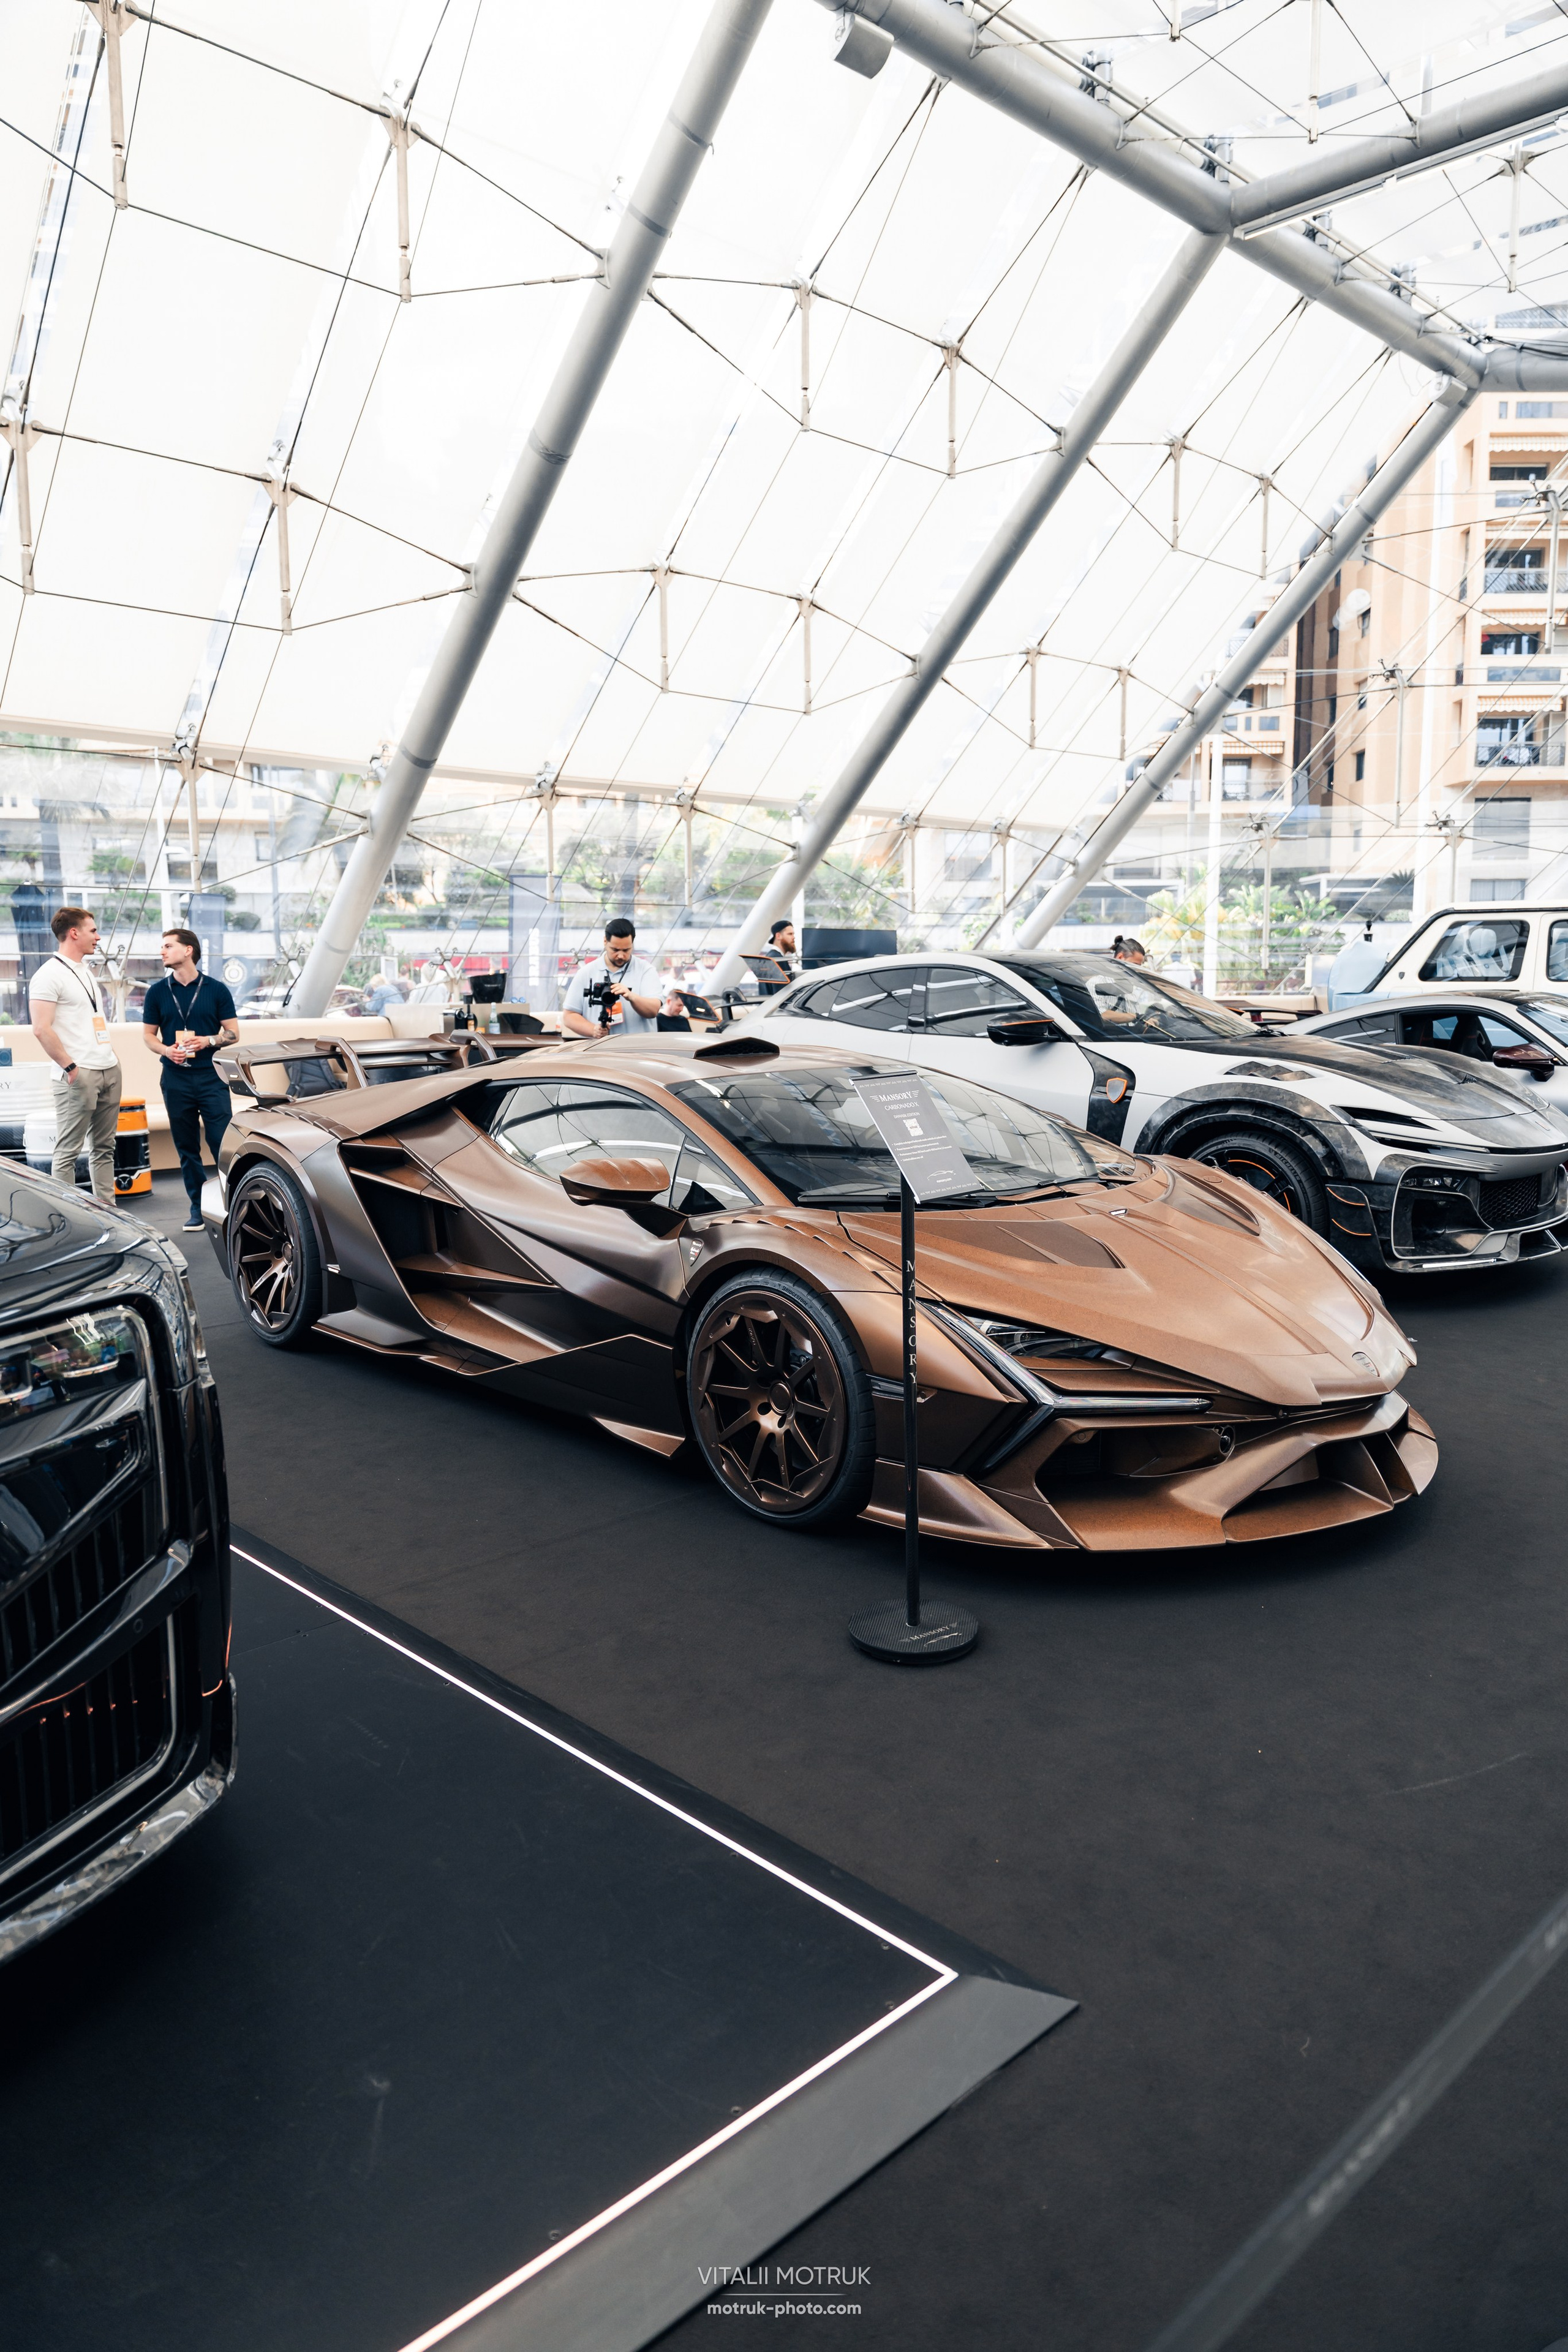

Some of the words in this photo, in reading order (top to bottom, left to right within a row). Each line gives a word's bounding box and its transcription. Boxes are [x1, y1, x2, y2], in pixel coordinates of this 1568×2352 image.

[878, 1091, 913, 1102] MANSORY
[1275, 1153, 1300, 1180] MICHELIN
[782, 1286, 809, 1306] BRIDGESTONE
[907, 1260, 917, 1384] MANSORY
[910, 1626, 949, 1641] MANSORY
